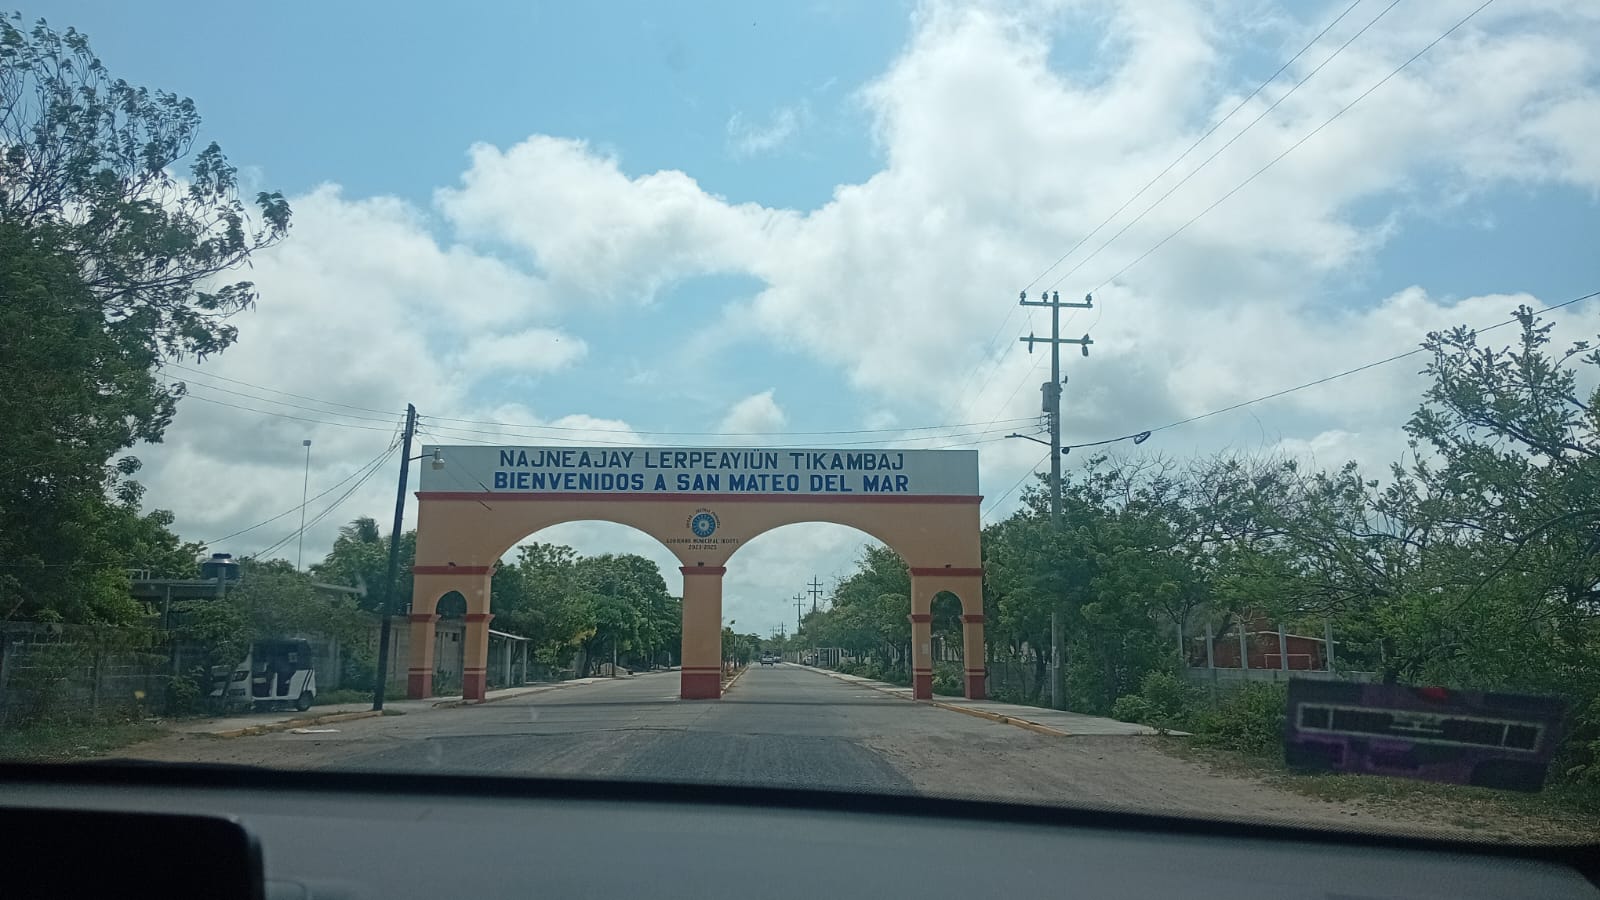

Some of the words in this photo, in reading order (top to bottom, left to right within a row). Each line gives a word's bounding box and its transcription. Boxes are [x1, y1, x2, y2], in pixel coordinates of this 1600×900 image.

[499, 449, 634, 469] NAJNEAJAY
[645, 449, 778, 470] LERPEAYIÜN
[789, 452, 904, 471] TIKAMBAJ
[494, 471, 644, 491] BIENVENIDOS
[654, 473, 667, 491] A
[677, 473, 720, 491] SAN
[729, 473, 799, 492] MATEO
[810, 474, 852, 492] DEL
[863, 474, 909, 492] MAR
